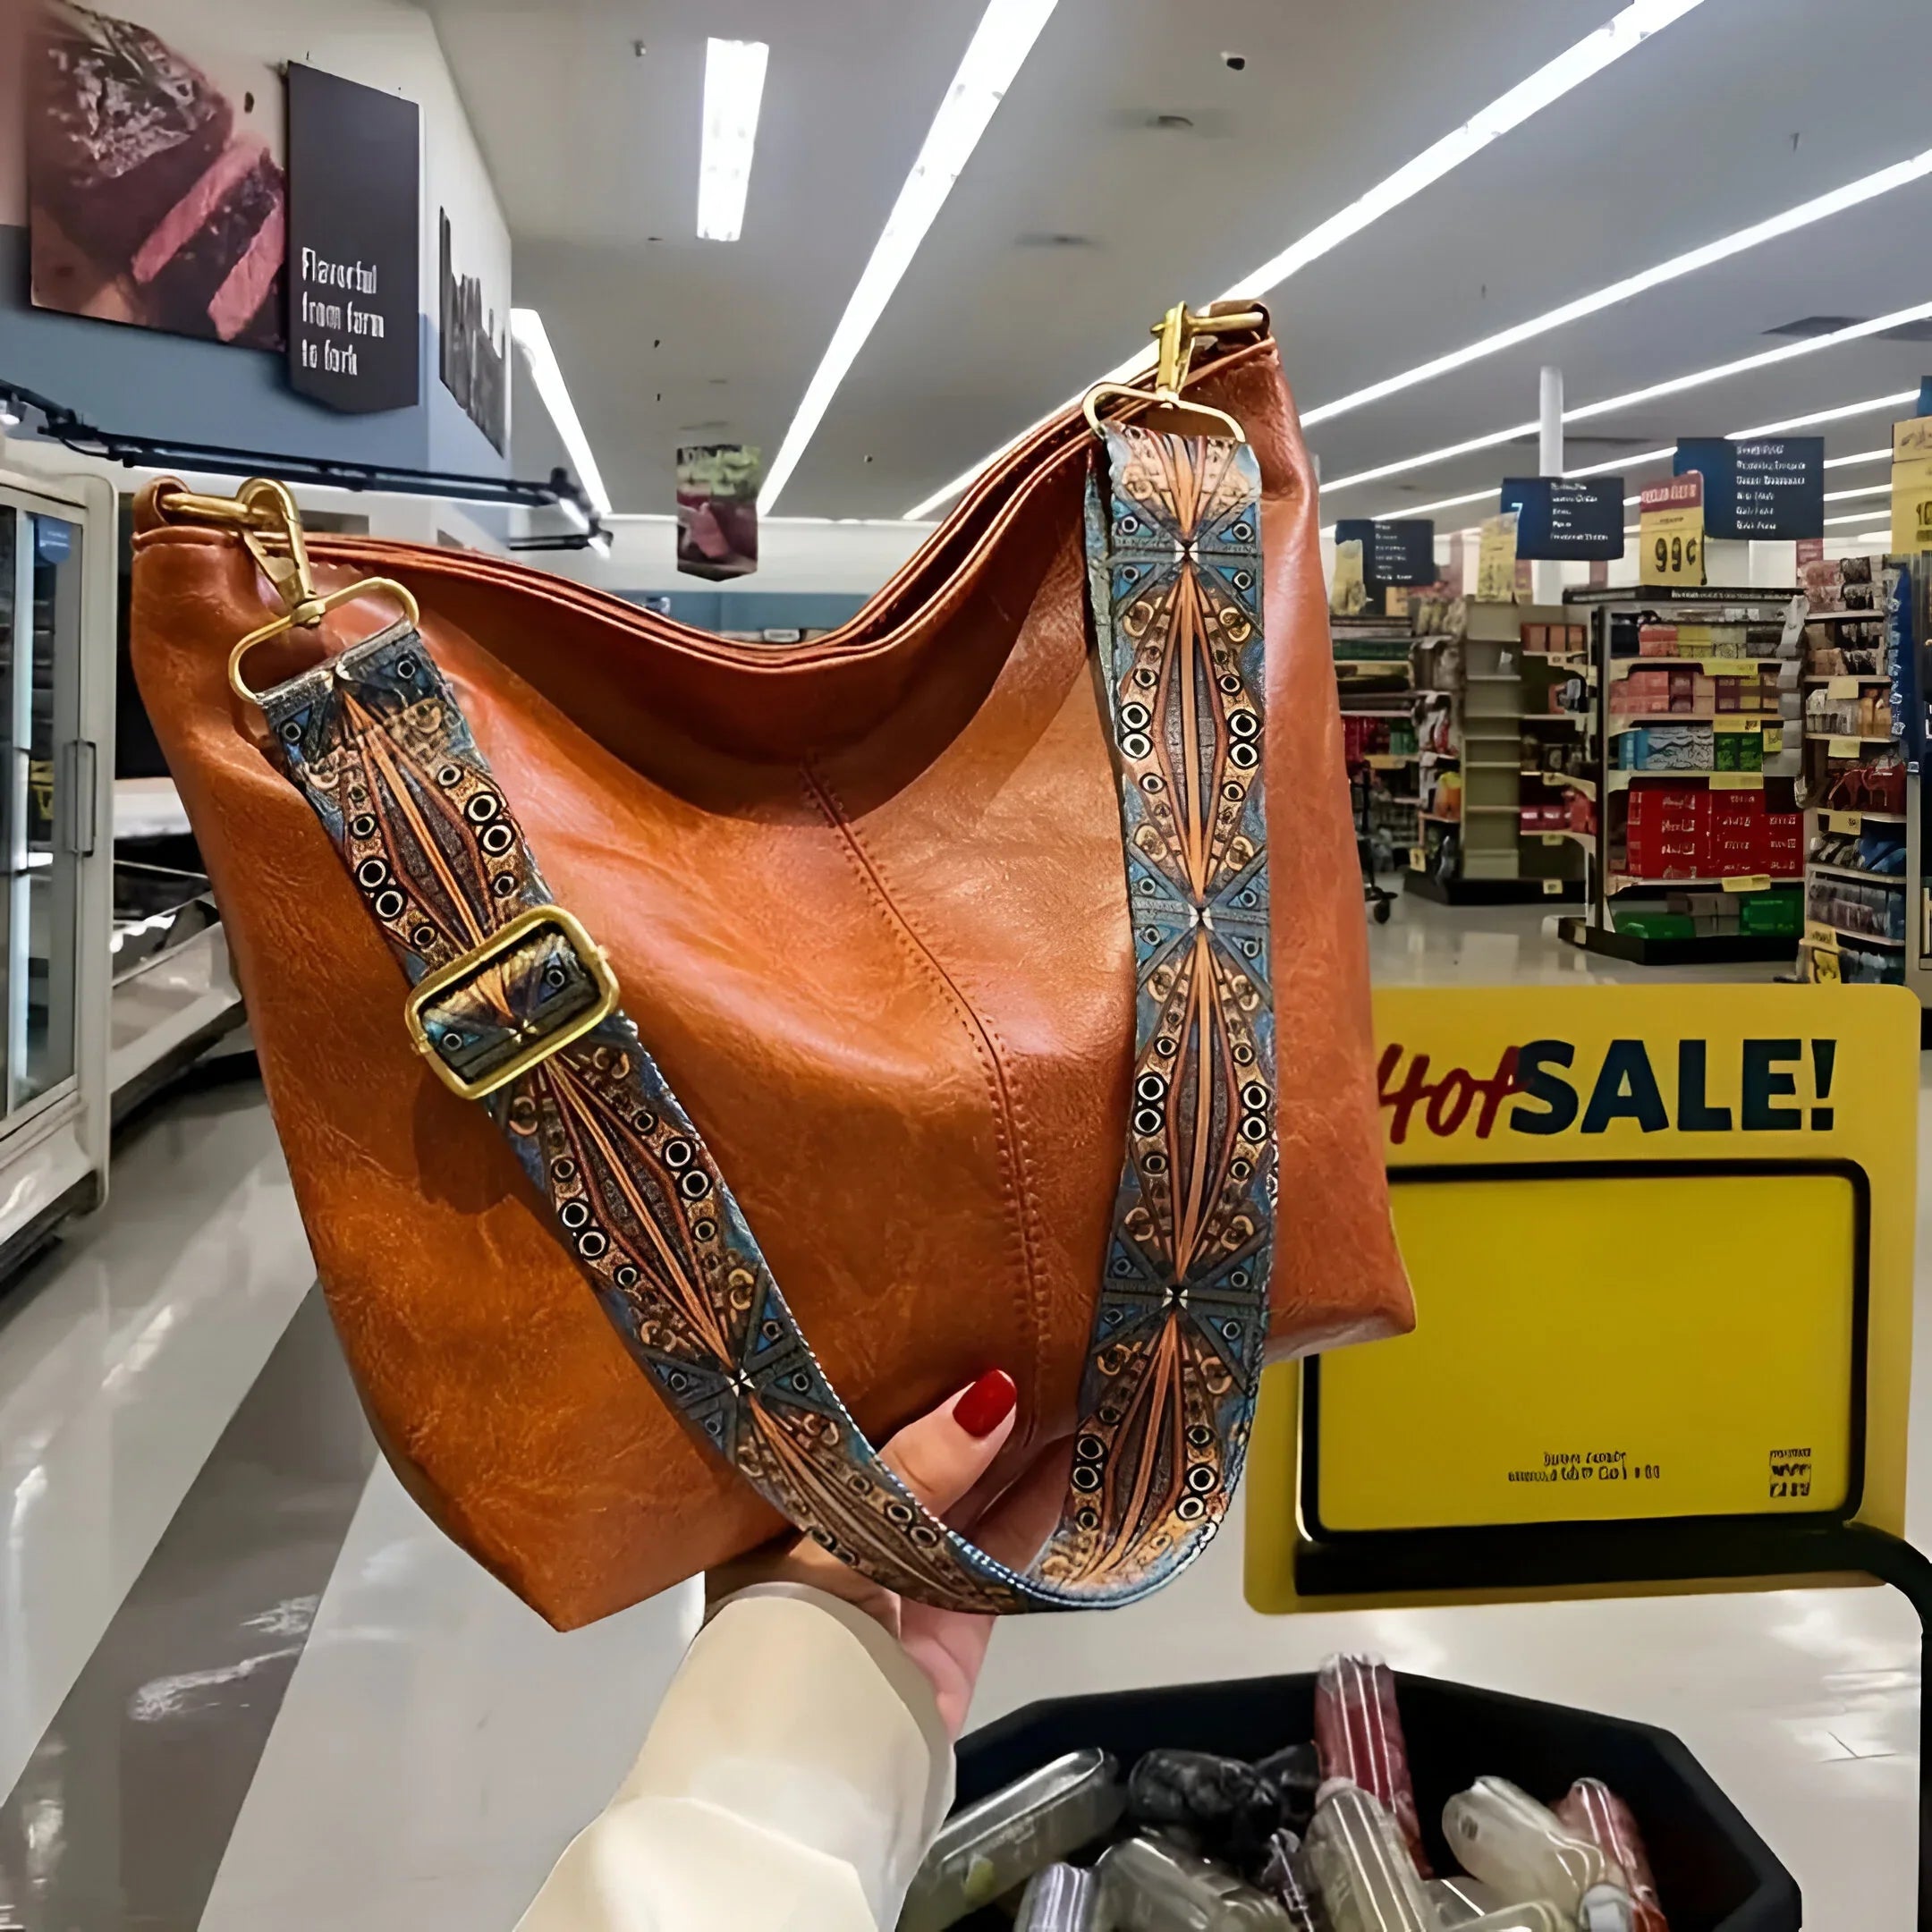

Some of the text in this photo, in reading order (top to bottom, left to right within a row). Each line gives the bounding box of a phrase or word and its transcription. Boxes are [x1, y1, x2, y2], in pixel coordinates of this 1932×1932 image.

[301, 291, 342, 330] from
[301, 339, 318, 368] to
[1509, 1038, 1837, 1135] SALE!
